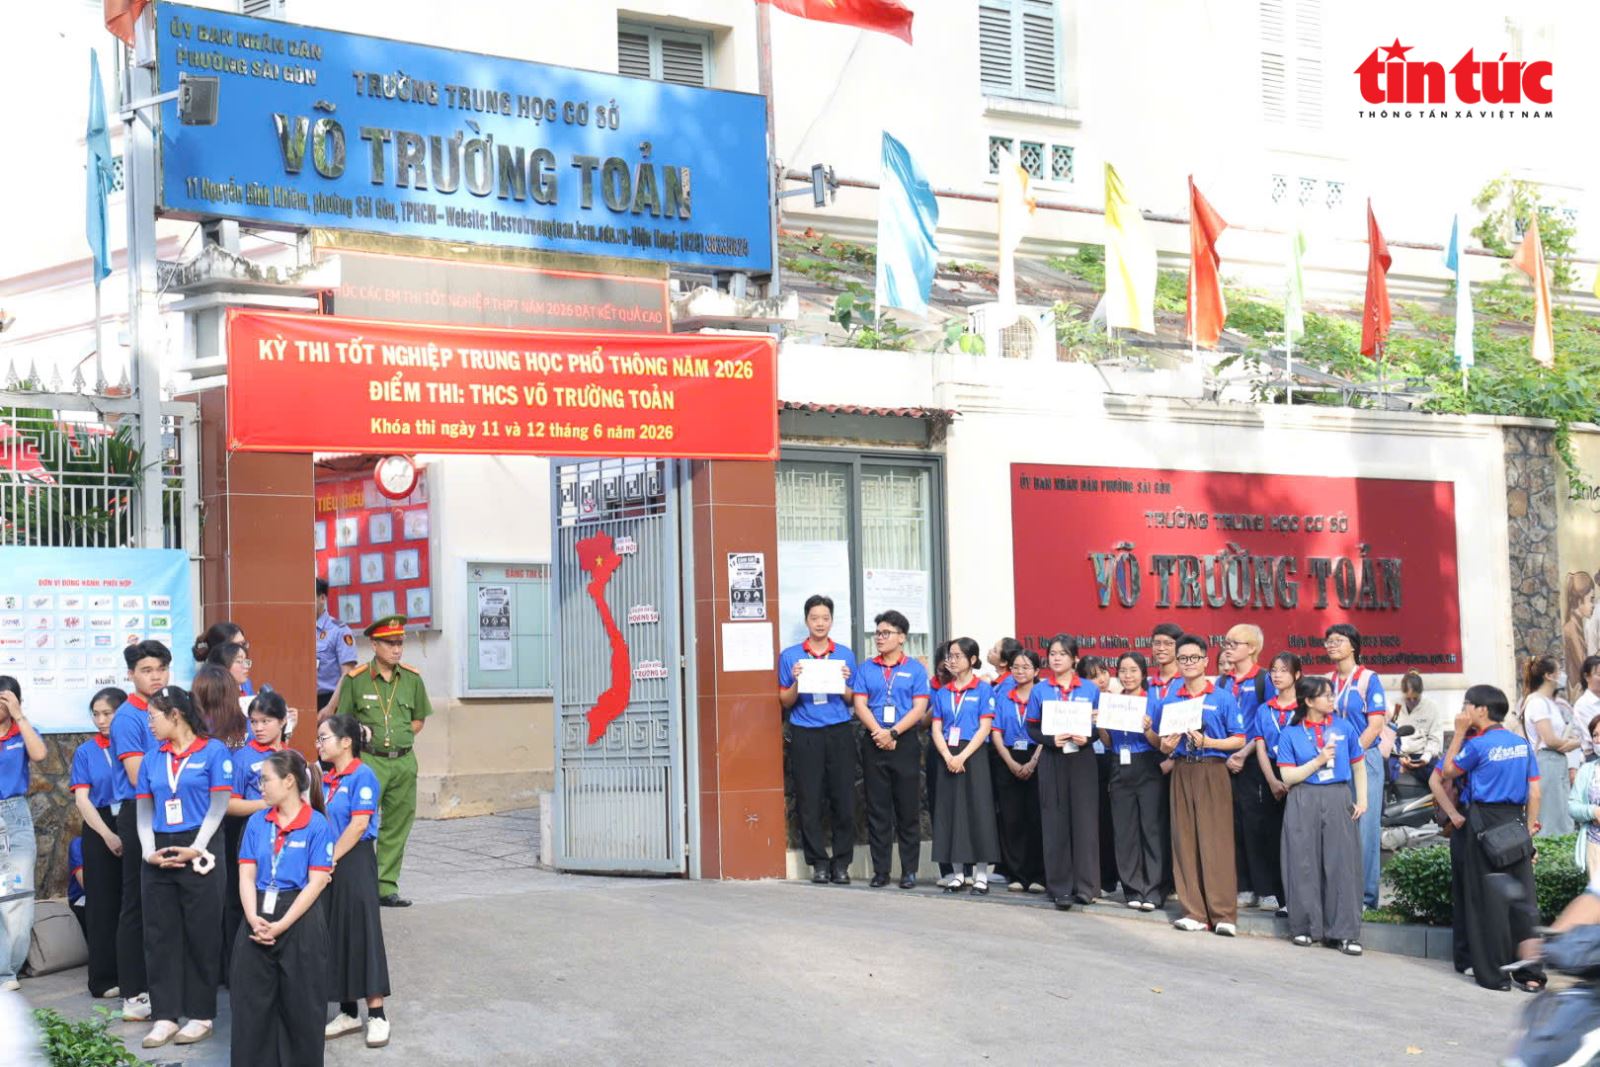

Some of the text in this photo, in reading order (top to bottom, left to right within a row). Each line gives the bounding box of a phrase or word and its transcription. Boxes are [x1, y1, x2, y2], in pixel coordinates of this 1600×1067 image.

[198, 25, 233, 46] BAN
[237, 31, 285, 54] NHÂN
[288, 38, 323, 61] DÂN
[177, 46, 317, 86] PHƯỜNG SÀI GÒN
[352, 70, 620, 130] TRƯỜNG TRUNG HỌC CƠ SỞ
[273, 99, 692, 220] VÕ TRƯỜNG TOẢN
[185, 176, 198, 200] 11
[356, 195, 373, 218] Sài
[385, 287, 399, 302] EM
[403, 290, 421, 305] THI
[548, 302, 574, 317] 2026
[642, 310, 663, 323] CAO
[259, 335, 753, 379] KỲ THI TỐT NGHIỆP TRUNG HỌC PHỔ THÔNG NĂM 2026
[369, 371, 675, 410] ĐIỂM THI: THCS VÕ TRƯỜNG TOẢN
[370, 418, 674, 441] Khóa thi ngày 11 và 12 tháng 6 năm 2026
[1213, 512, 1265, 531] TRUNG
[1269, 514, 1300, 534] HỌC
[1088, 541, 1402, 610] VÕ TRƯỜNG TOẢN
